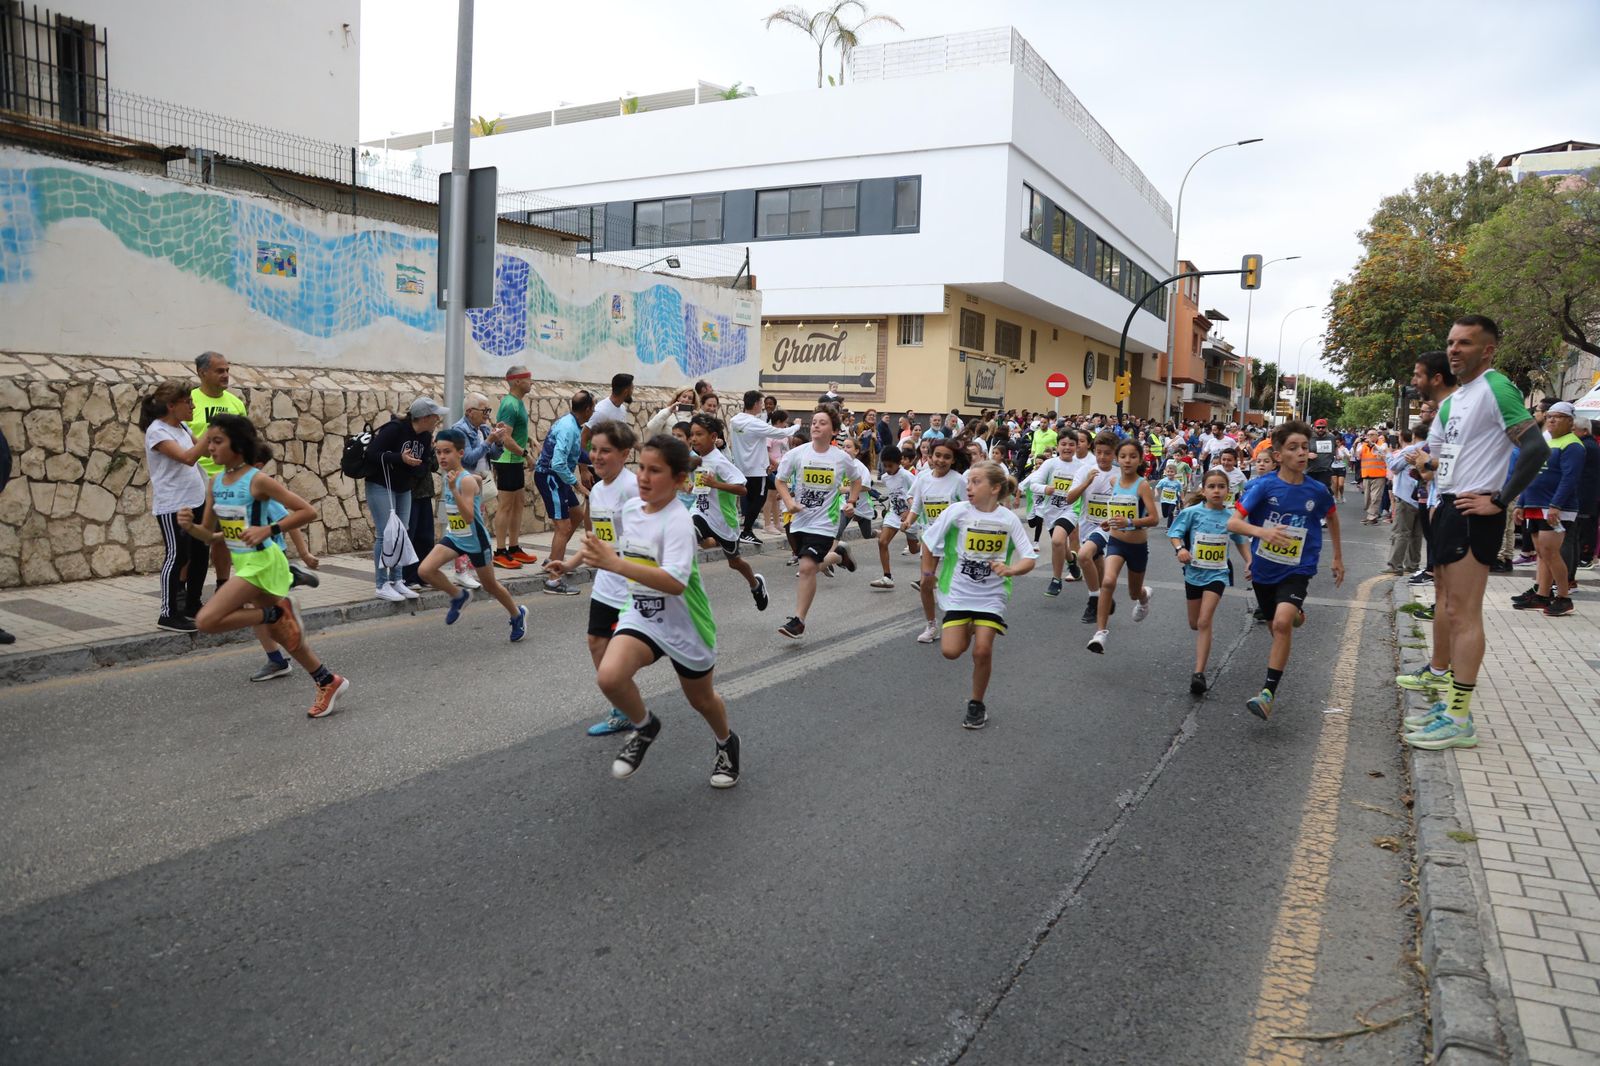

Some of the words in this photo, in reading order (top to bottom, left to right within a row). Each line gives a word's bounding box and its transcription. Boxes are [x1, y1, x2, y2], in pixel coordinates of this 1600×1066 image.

[772, 330, 848, 372] Grand
[974, 367, 996, 395] Grand
[805, 473, 832, 485] 1036
[967, 538, 1003, 552] 1039
[1198, 549, 1224, 561] 1004
